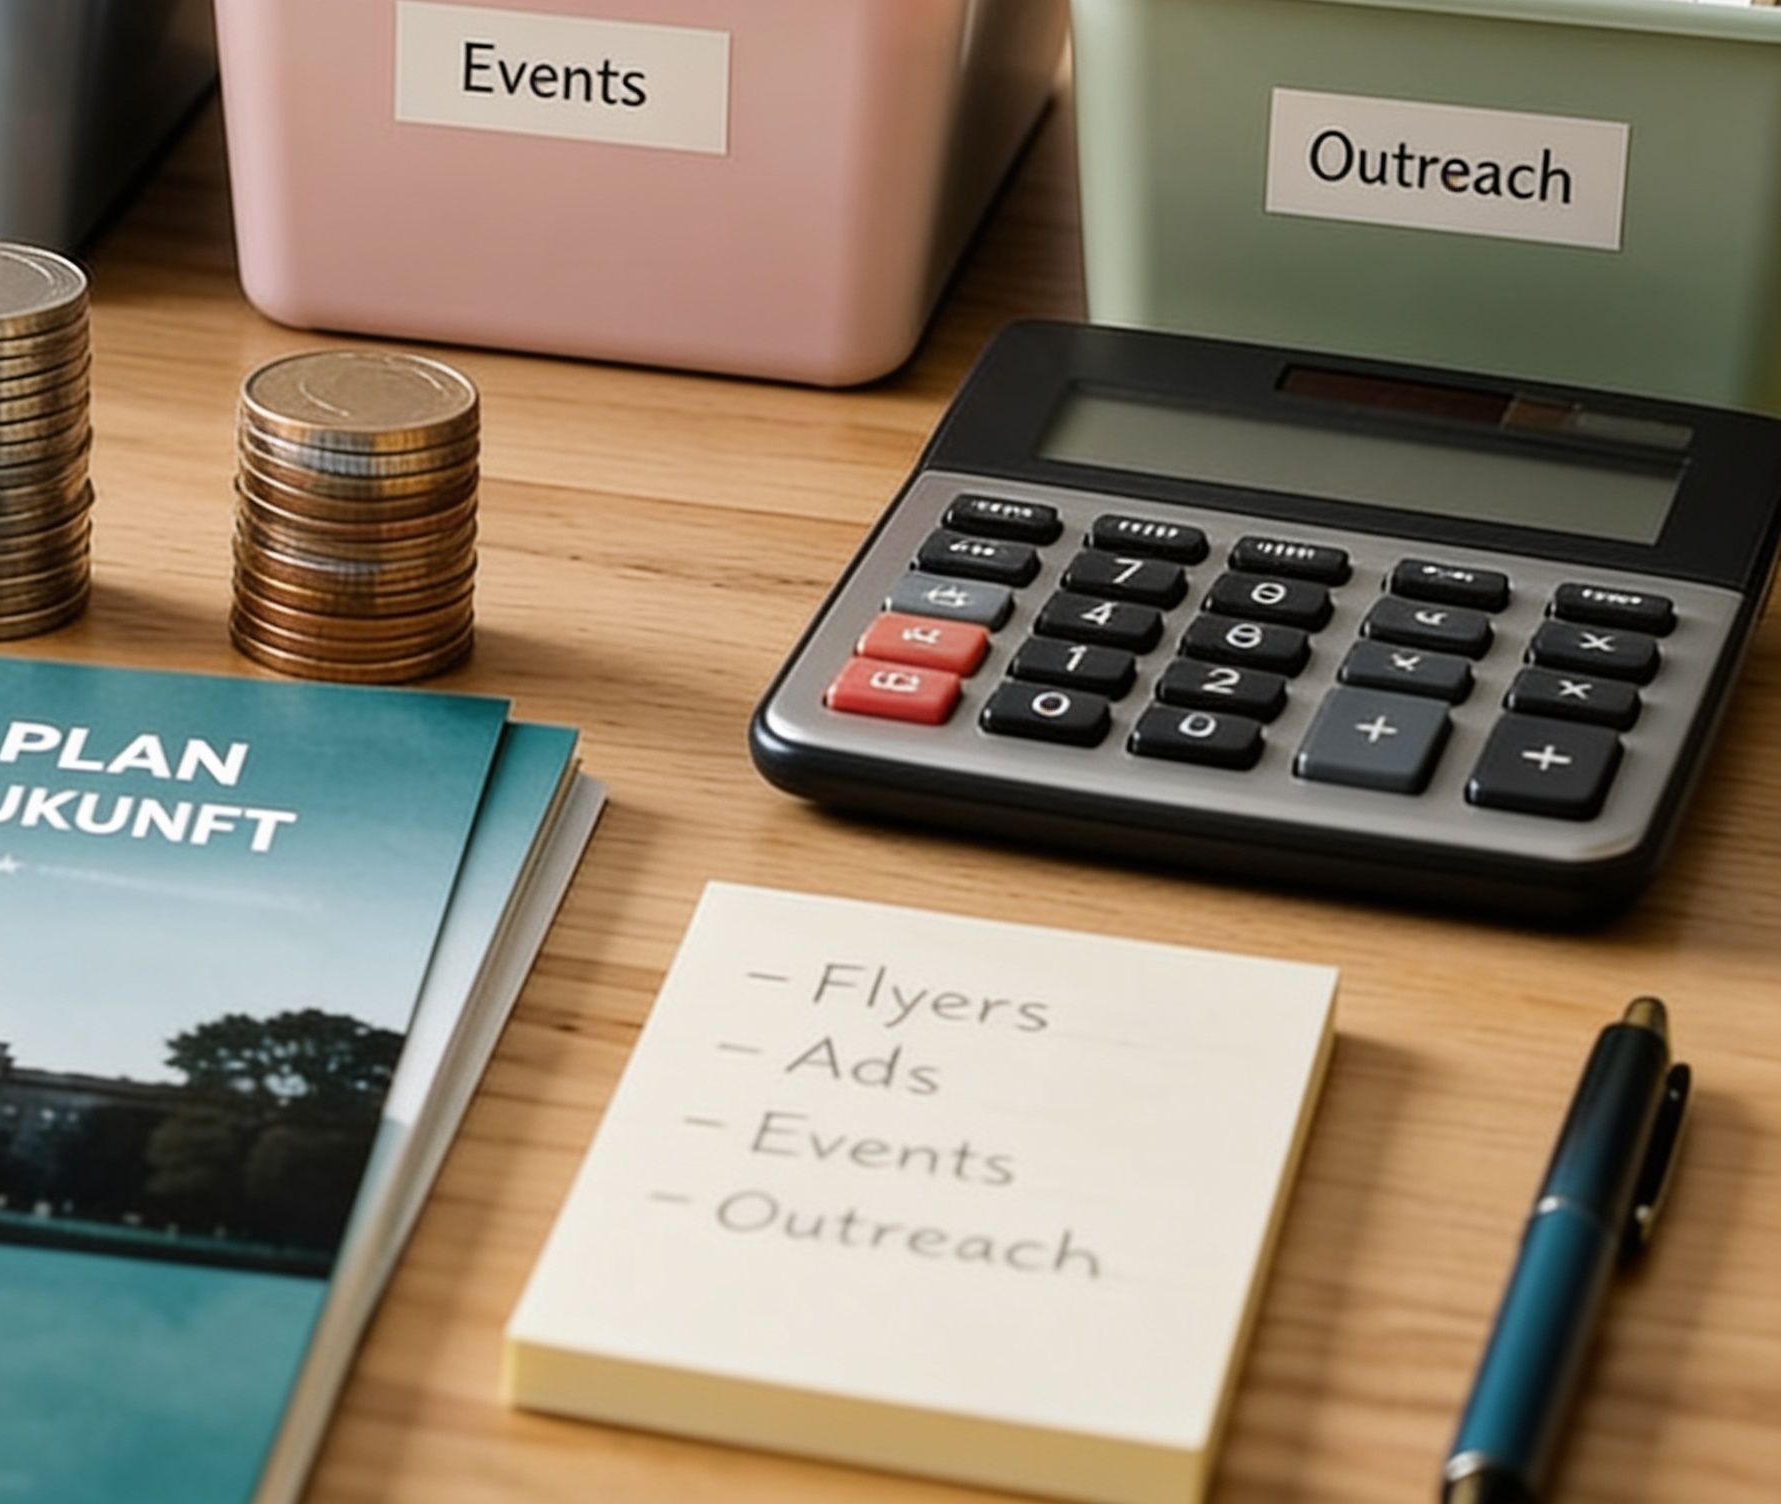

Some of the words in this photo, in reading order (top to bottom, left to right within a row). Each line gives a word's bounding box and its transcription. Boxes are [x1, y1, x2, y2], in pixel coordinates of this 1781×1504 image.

[463, 41, 647, 107] Events
[1310, 130, 1571, 204] Outreach
[1112, 558, 1143, 584] 7
[1080, 601, 1119, 626] 4
[1066, 645, 1088, 672] 1
[1201, 667, 1240, 694] 2
[812, 963, 1050, 1033] Flyers
[785, 1035, 942, 1096] Ads
[750, 1110, 1016, 1187] Events
[714, 1189, 1101, 1280] Outreach
